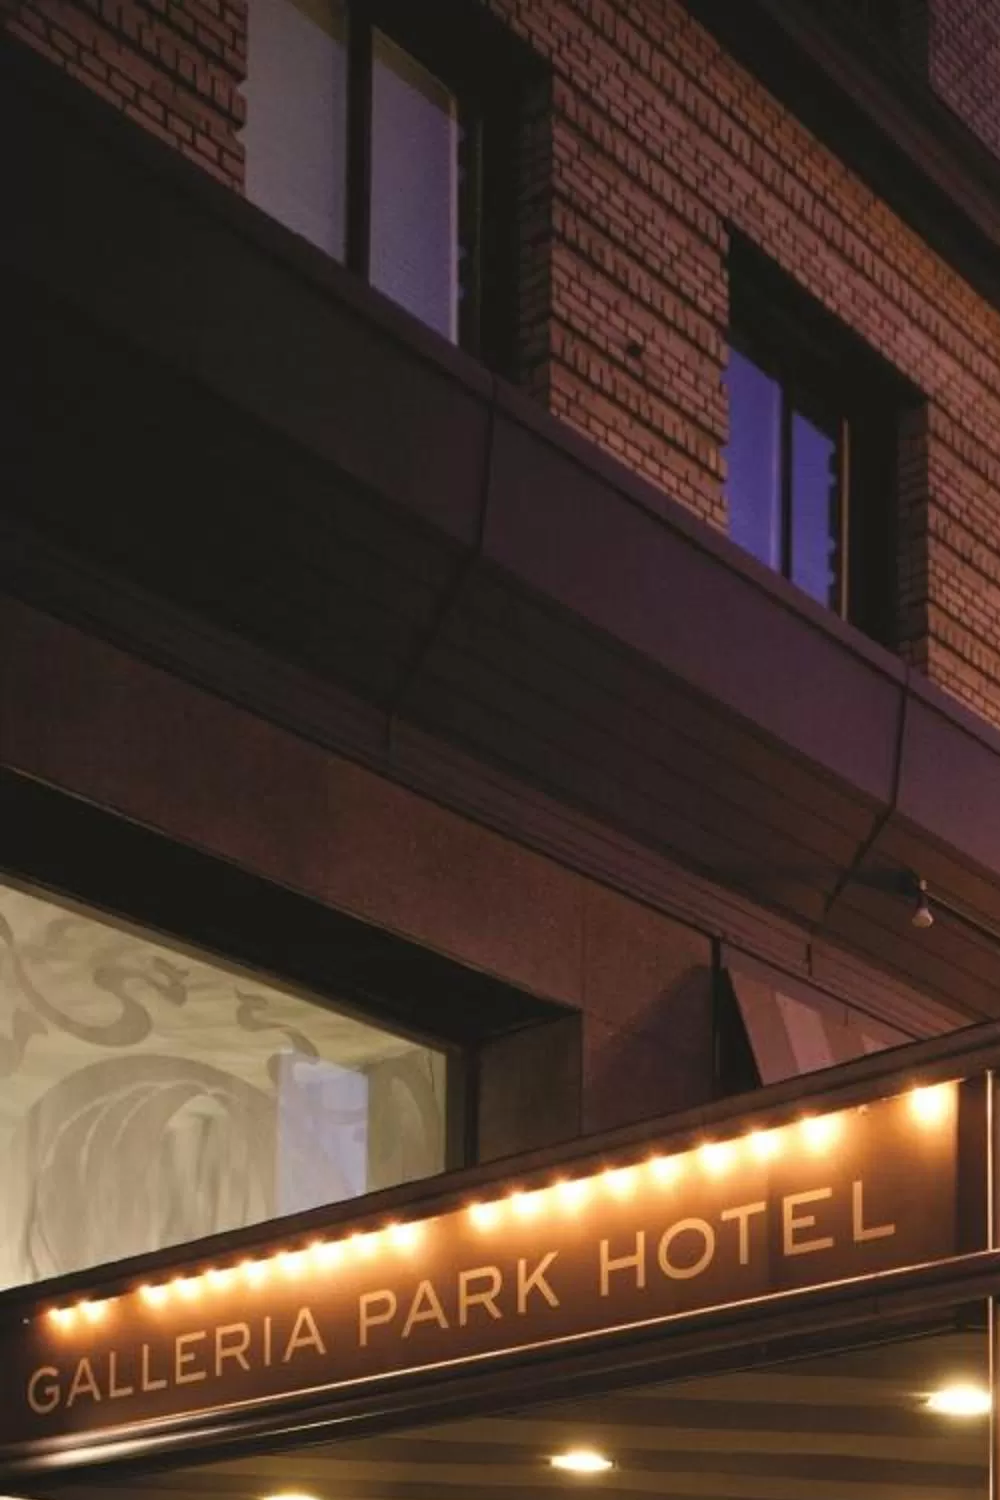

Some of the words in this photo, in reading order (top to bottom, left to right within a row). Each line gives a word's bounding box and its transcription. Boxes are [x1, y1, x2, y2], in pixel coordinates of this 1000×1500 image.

[28, 1309, 326, 1416] GALLERIA
[358, 1250, 560, 1348] PARK
[599, 1180, 896, 1297] HOTEL
